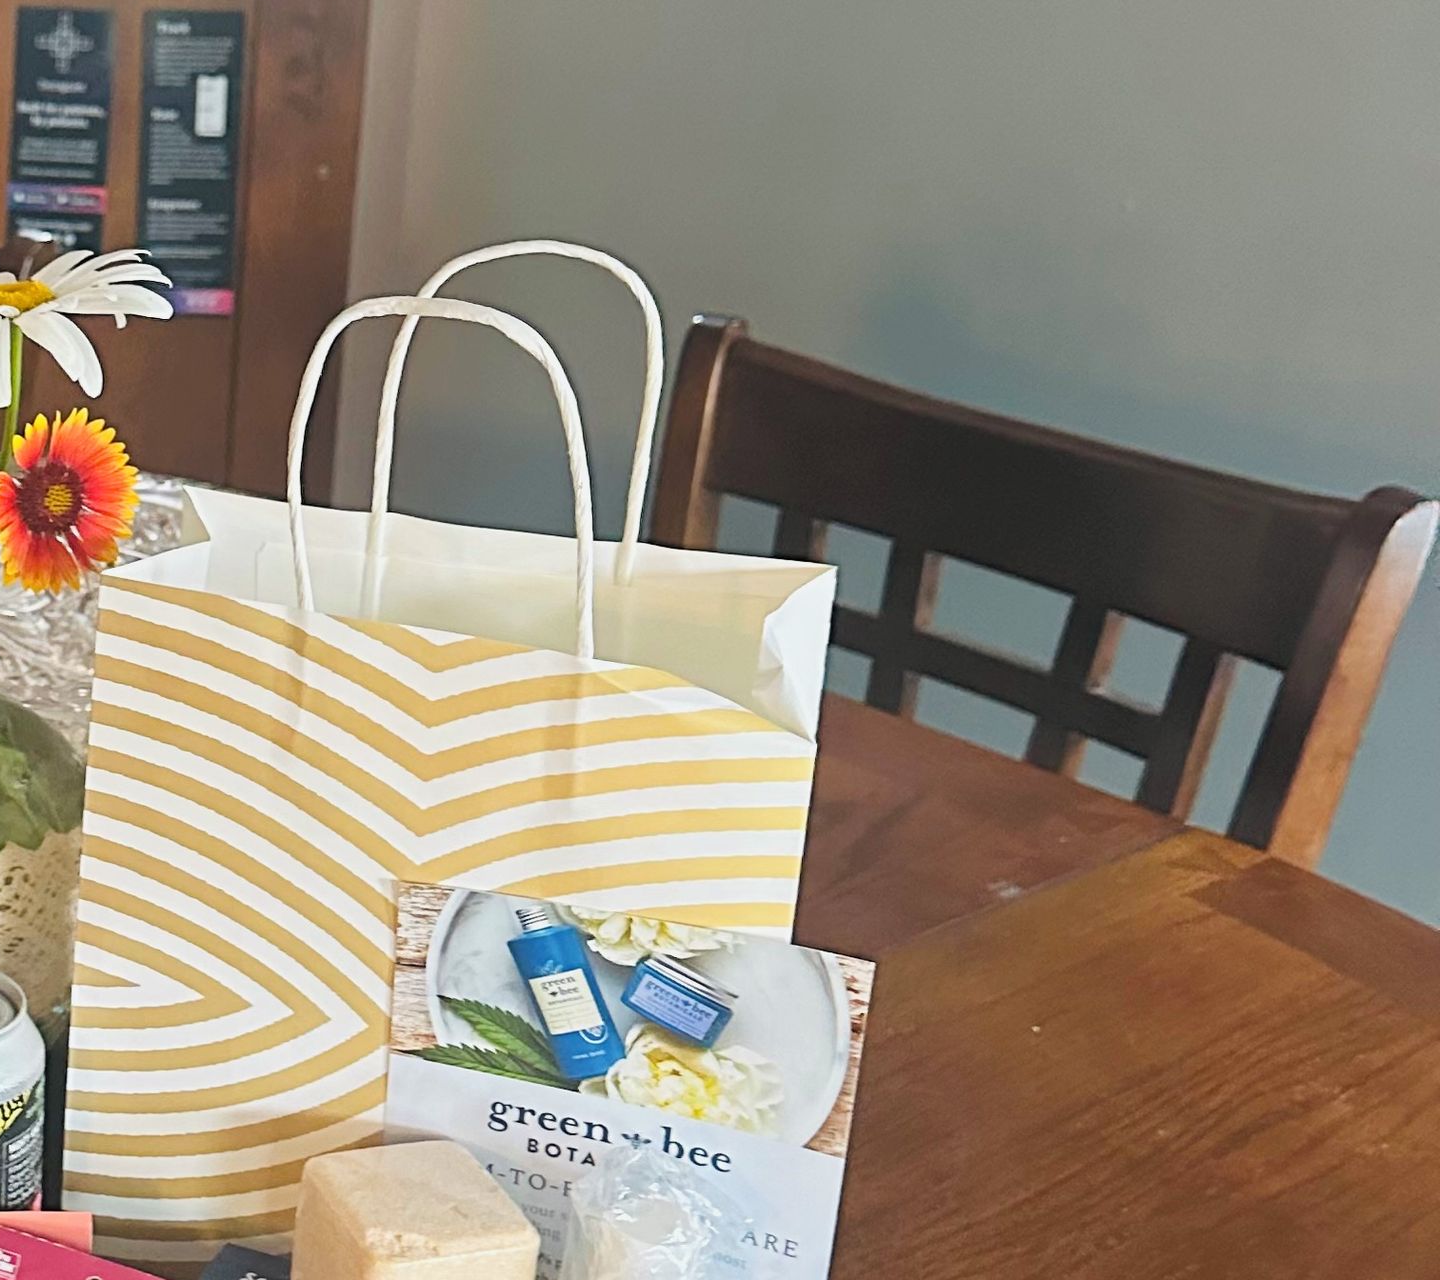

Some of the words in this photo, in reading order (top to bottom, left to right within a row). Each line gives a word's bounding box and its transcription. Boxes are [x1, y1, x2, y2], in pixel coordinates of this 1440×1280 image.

[487, 1099, 612, 1144] green
[660, 1125, 733, 1173] bee
[526, 1139, 597, 1168] BOTA
[741, 1229, 799, 1258] ARE
